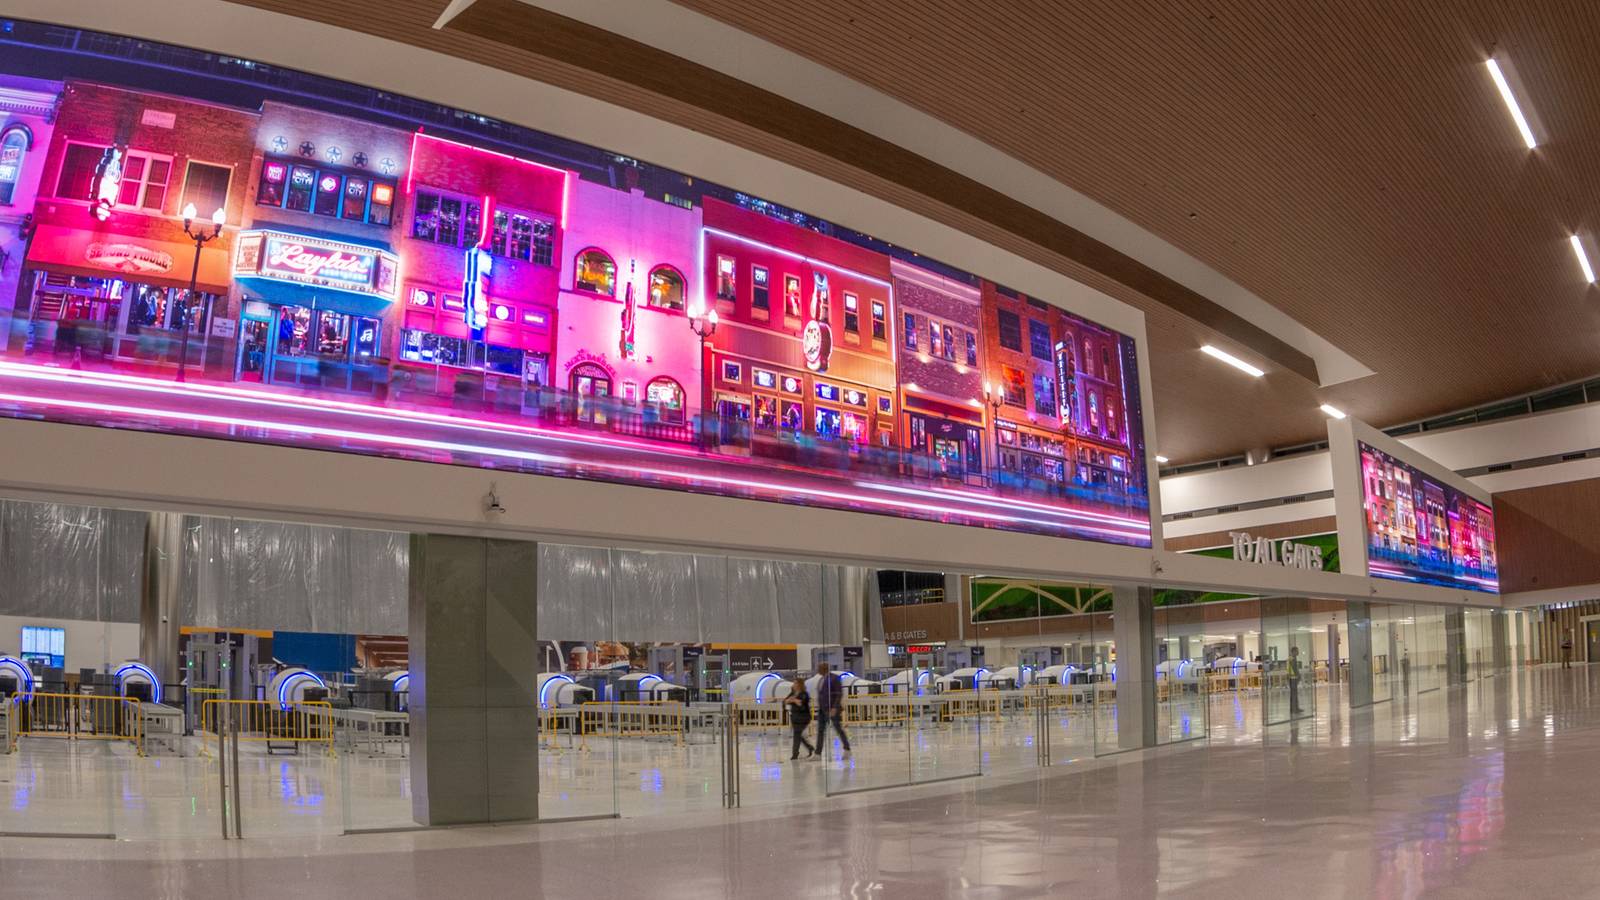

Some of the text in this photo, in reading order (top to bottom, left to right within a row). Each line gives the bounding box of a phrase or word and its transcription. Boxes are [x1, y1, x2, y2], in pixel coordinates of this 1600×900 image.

[294, 176, 314, 185] CITY
[348, 187, 363, 196] CITY
[270, 244, 368, 275] Layla's
[1229, 531, 1254, 561] TO
[1281, 540, 1323, 571] GATES
[884, 632, 890, 640] A
[896, 631, 902, 640] B
[902, 630, 928, 639] GATES
